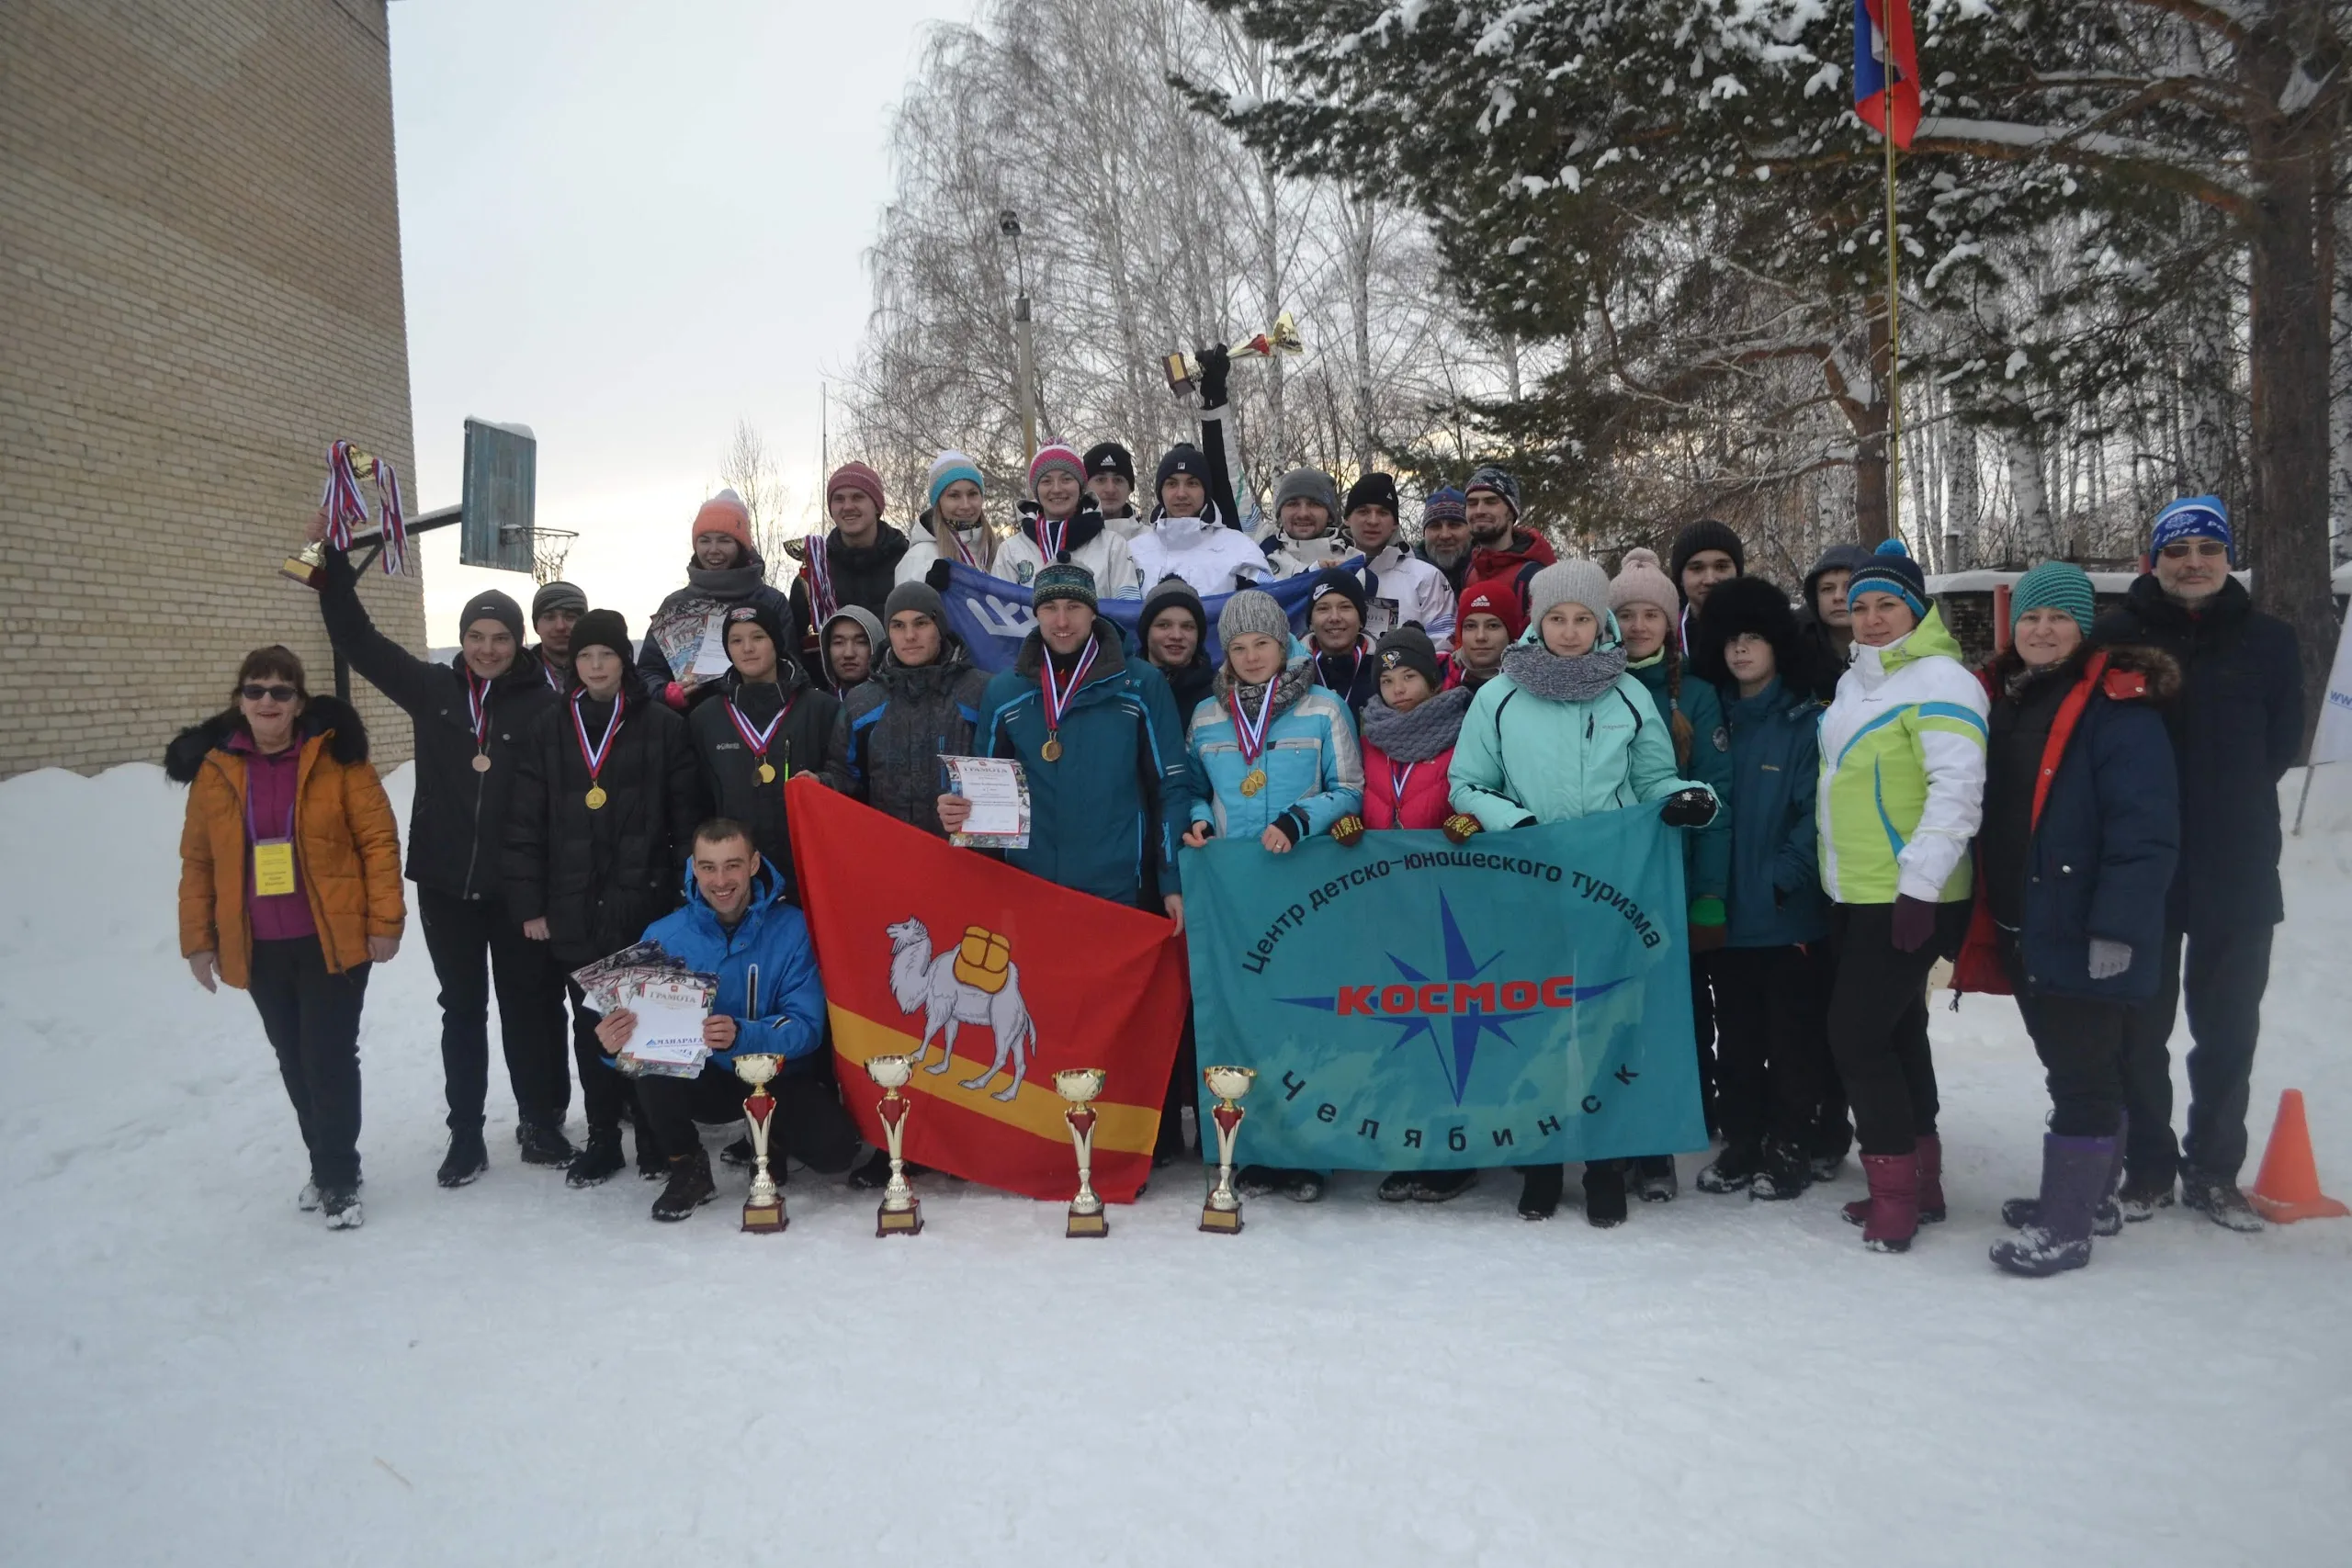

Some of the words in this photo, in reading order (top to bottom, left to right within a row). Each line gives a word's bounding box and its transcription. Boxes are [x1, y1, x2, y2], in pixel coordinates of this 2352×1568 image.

[1244, 905, 1306, 976] Центр
[1312, 851, 1564, 909] детско-юношеского
[1571, 870, 1661, 950] туризма
[650, 991, 696, 1004] ГРАМОТА
[1336, 975, 1575, 1017] КОСМОС
[657, 1036, 704, 1044] МАНАРАГА
[1282, 1062, 1641, 1154] Челябинск
